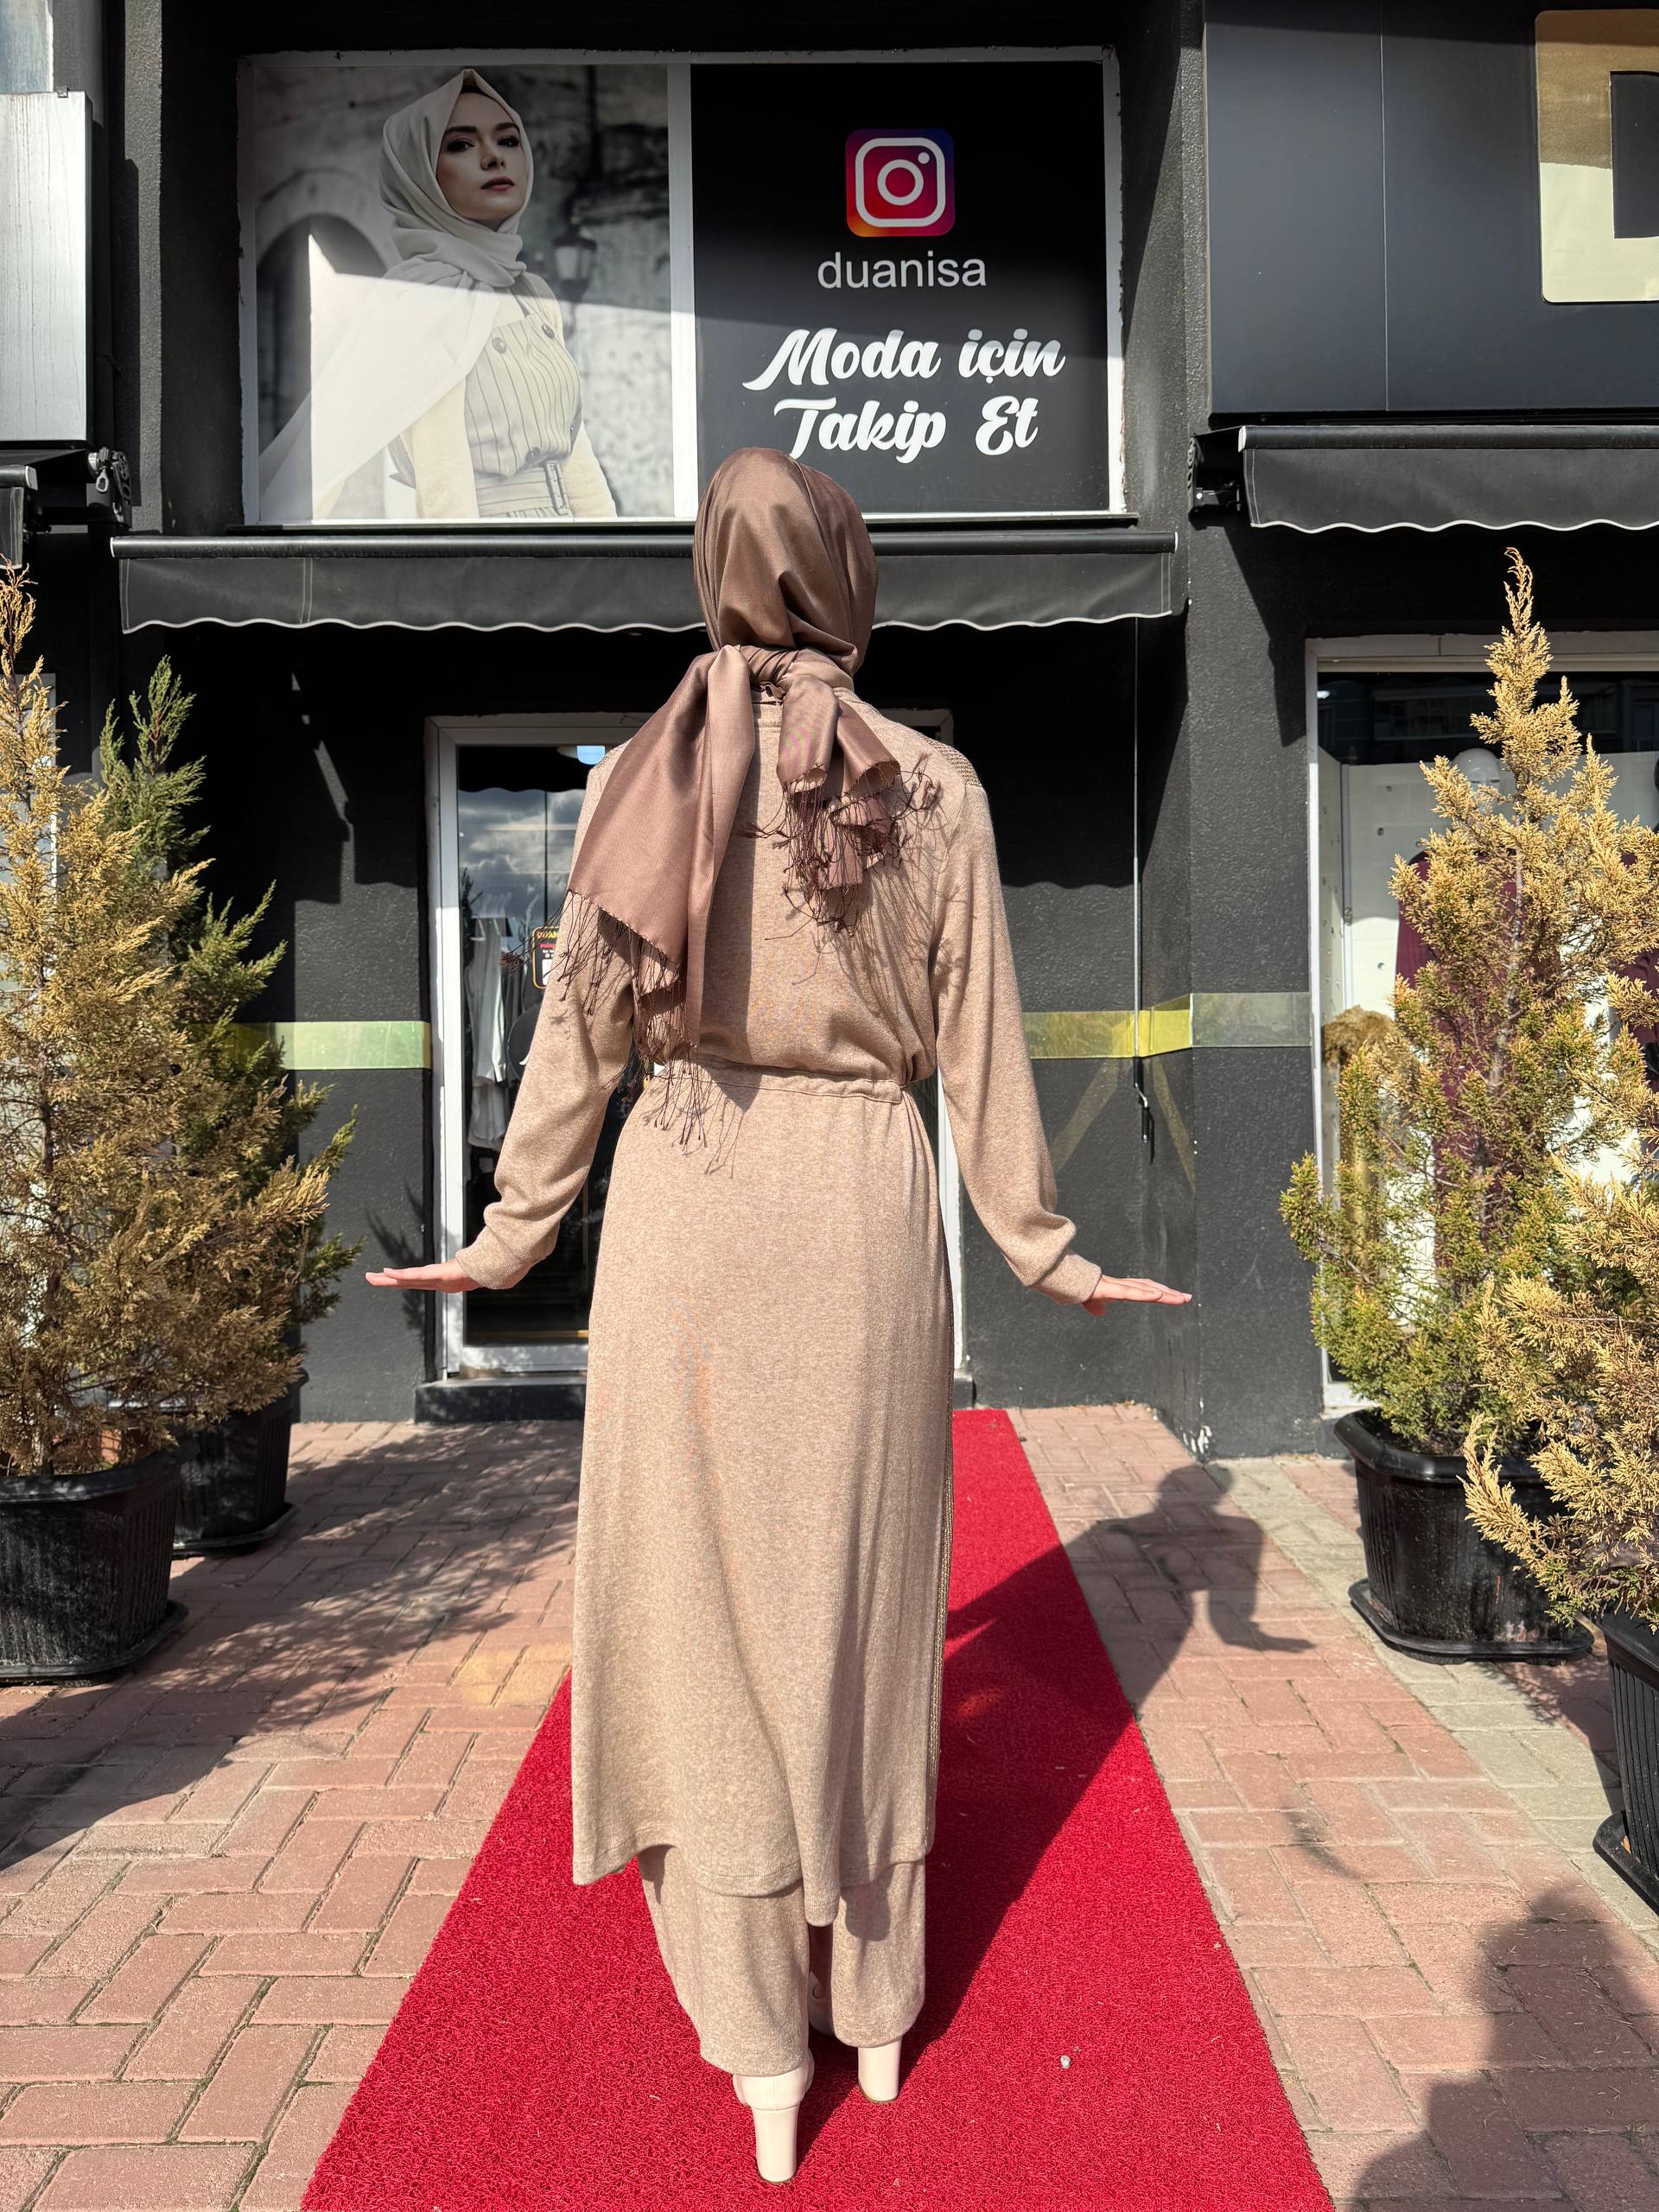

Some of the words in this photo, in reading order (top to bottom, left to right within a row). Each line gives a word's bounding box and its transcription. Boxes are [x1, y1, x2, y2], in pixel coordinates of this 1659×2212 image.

[817, 250, 987, 289] duanisa
[741, 327, 942, 391] Moda
[957, 327, 1066, 385] için
[773, 397, 947, 464] Takip
[975, 395, 1039, 456] Et
